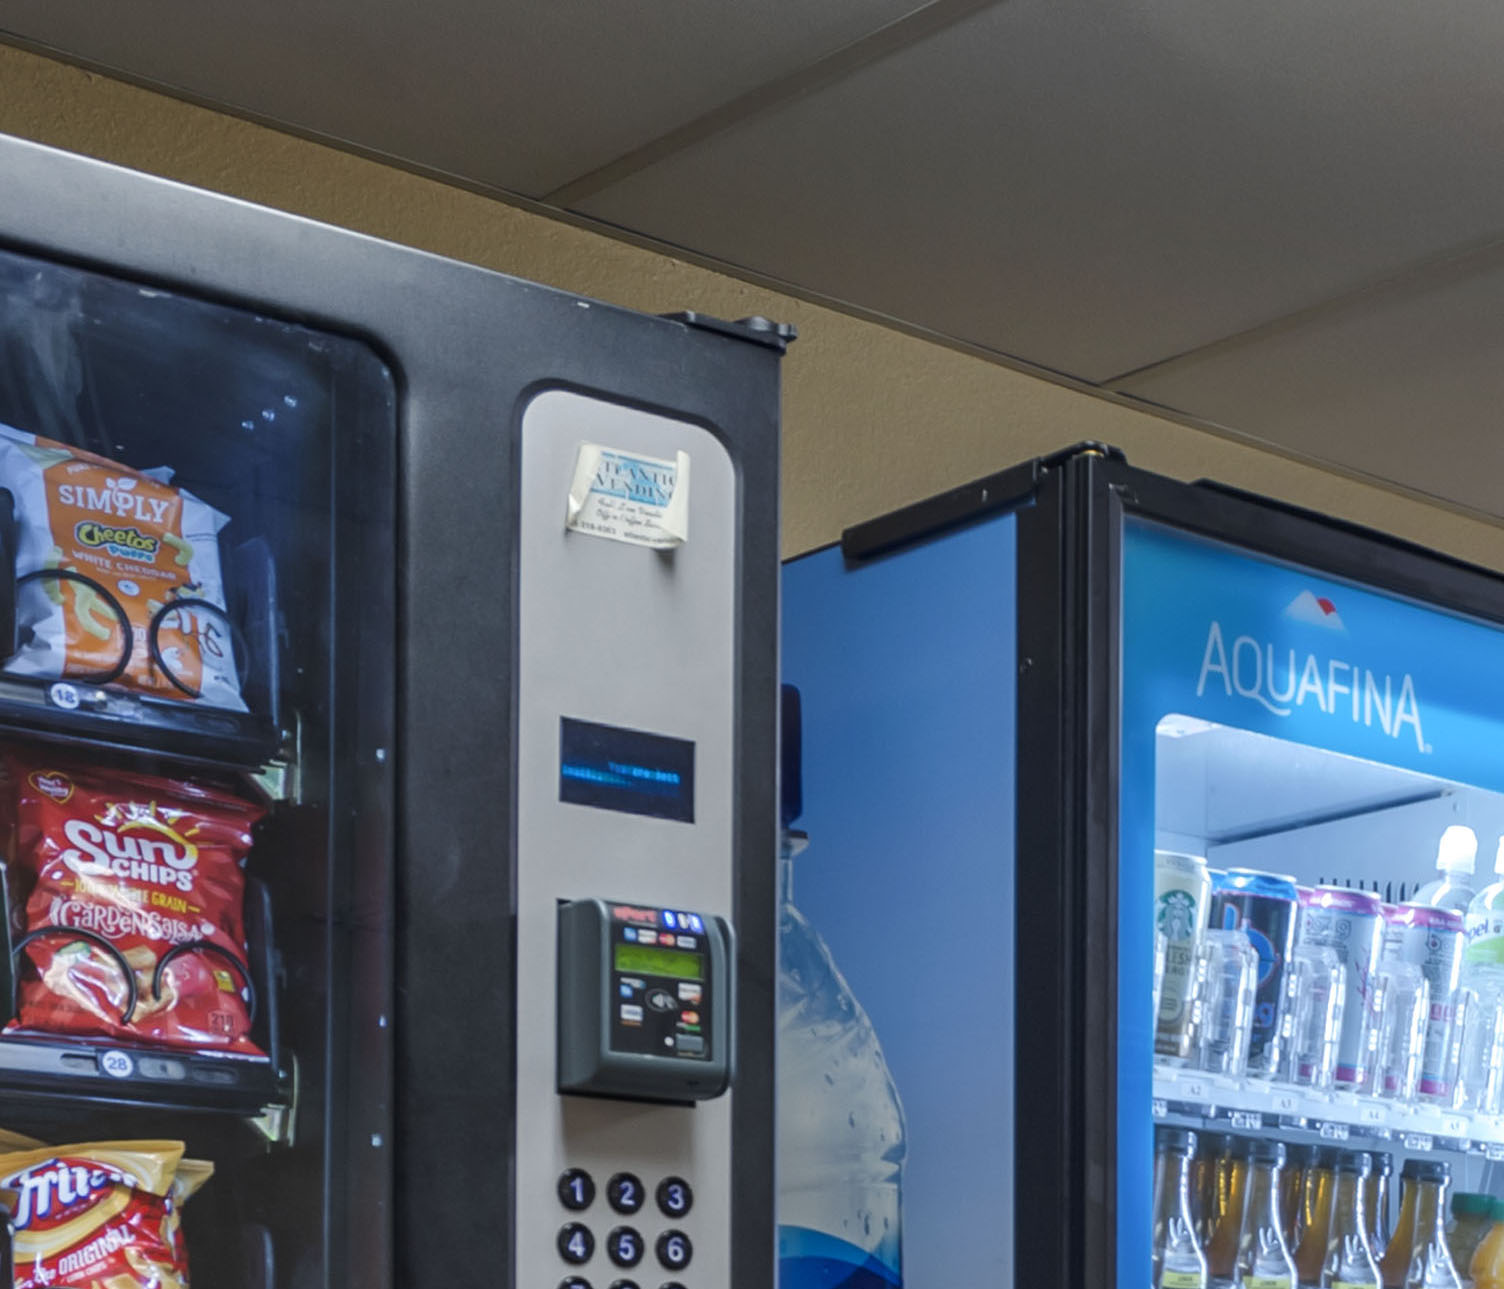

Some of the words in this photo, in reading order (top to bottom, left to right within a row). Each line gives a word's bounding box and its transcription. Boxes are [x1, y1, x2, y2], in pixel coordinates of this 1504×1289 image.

[58, 483, 169, 524] SIMPLY
[77, 522, 158, 552] Cheetos
[1196, 620, 1427, 755] AQUAFINA
[63, 819, 199, 877] Sun
[111, 858, 193, 892] CHIPS
[151, 891, 188, 914] GRAIN
[107, 1057, 127, 1070] 28
[570, 1176, 585, 1203] 1
[619, 1180, 636, 1206] 2
[667, 1184, 685, 1210] 3
[58, 1224, 136, 1276] ORIGINAL
[568, 1231, 586, 1258] 4
[618, 1234, 636, 1261] 5
[667, 1236, 685, 1263] 6
